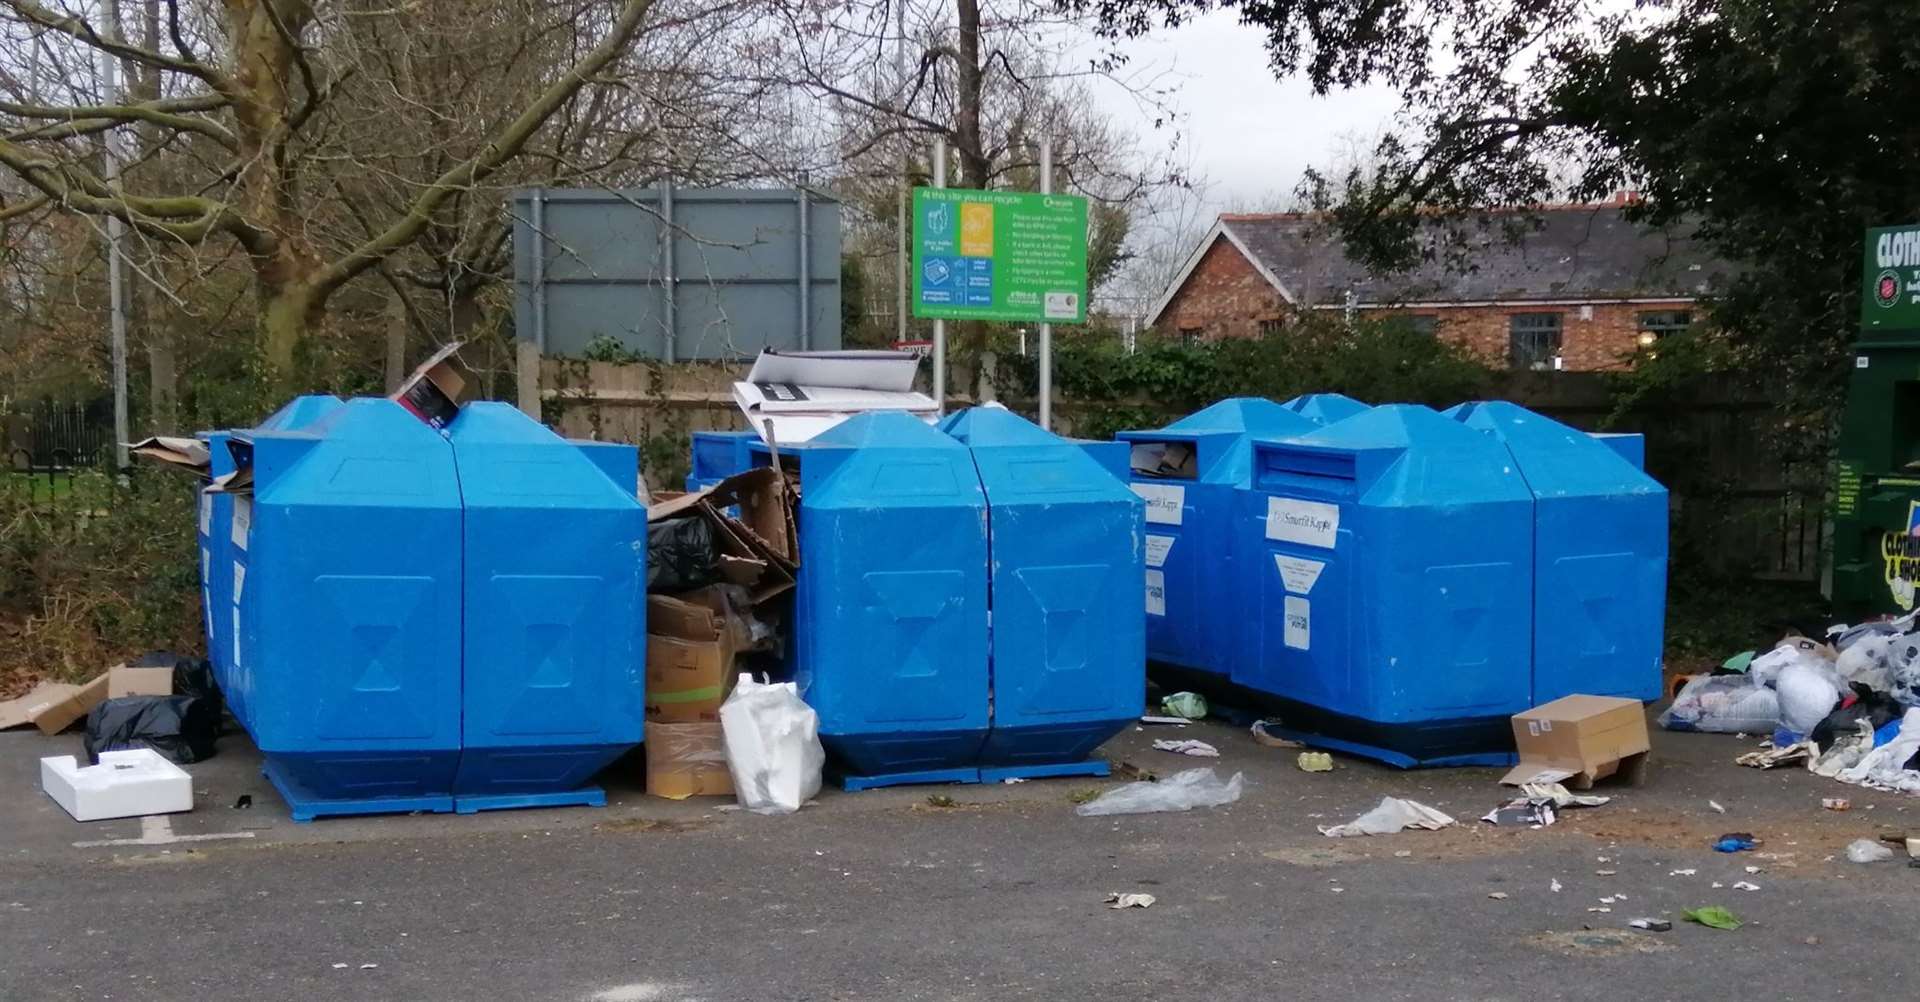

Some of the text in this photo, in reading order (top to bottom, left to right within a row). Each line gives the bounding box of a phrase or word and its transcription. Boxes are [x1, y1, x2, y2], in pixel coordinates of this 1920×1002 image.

[931, 190, 946, 199] this
[949, 191, 961, 200] site
[963, 193, 977, 203] you
[978, 194, 993, 203] can
[903, 345, 926, 355] GIVE
